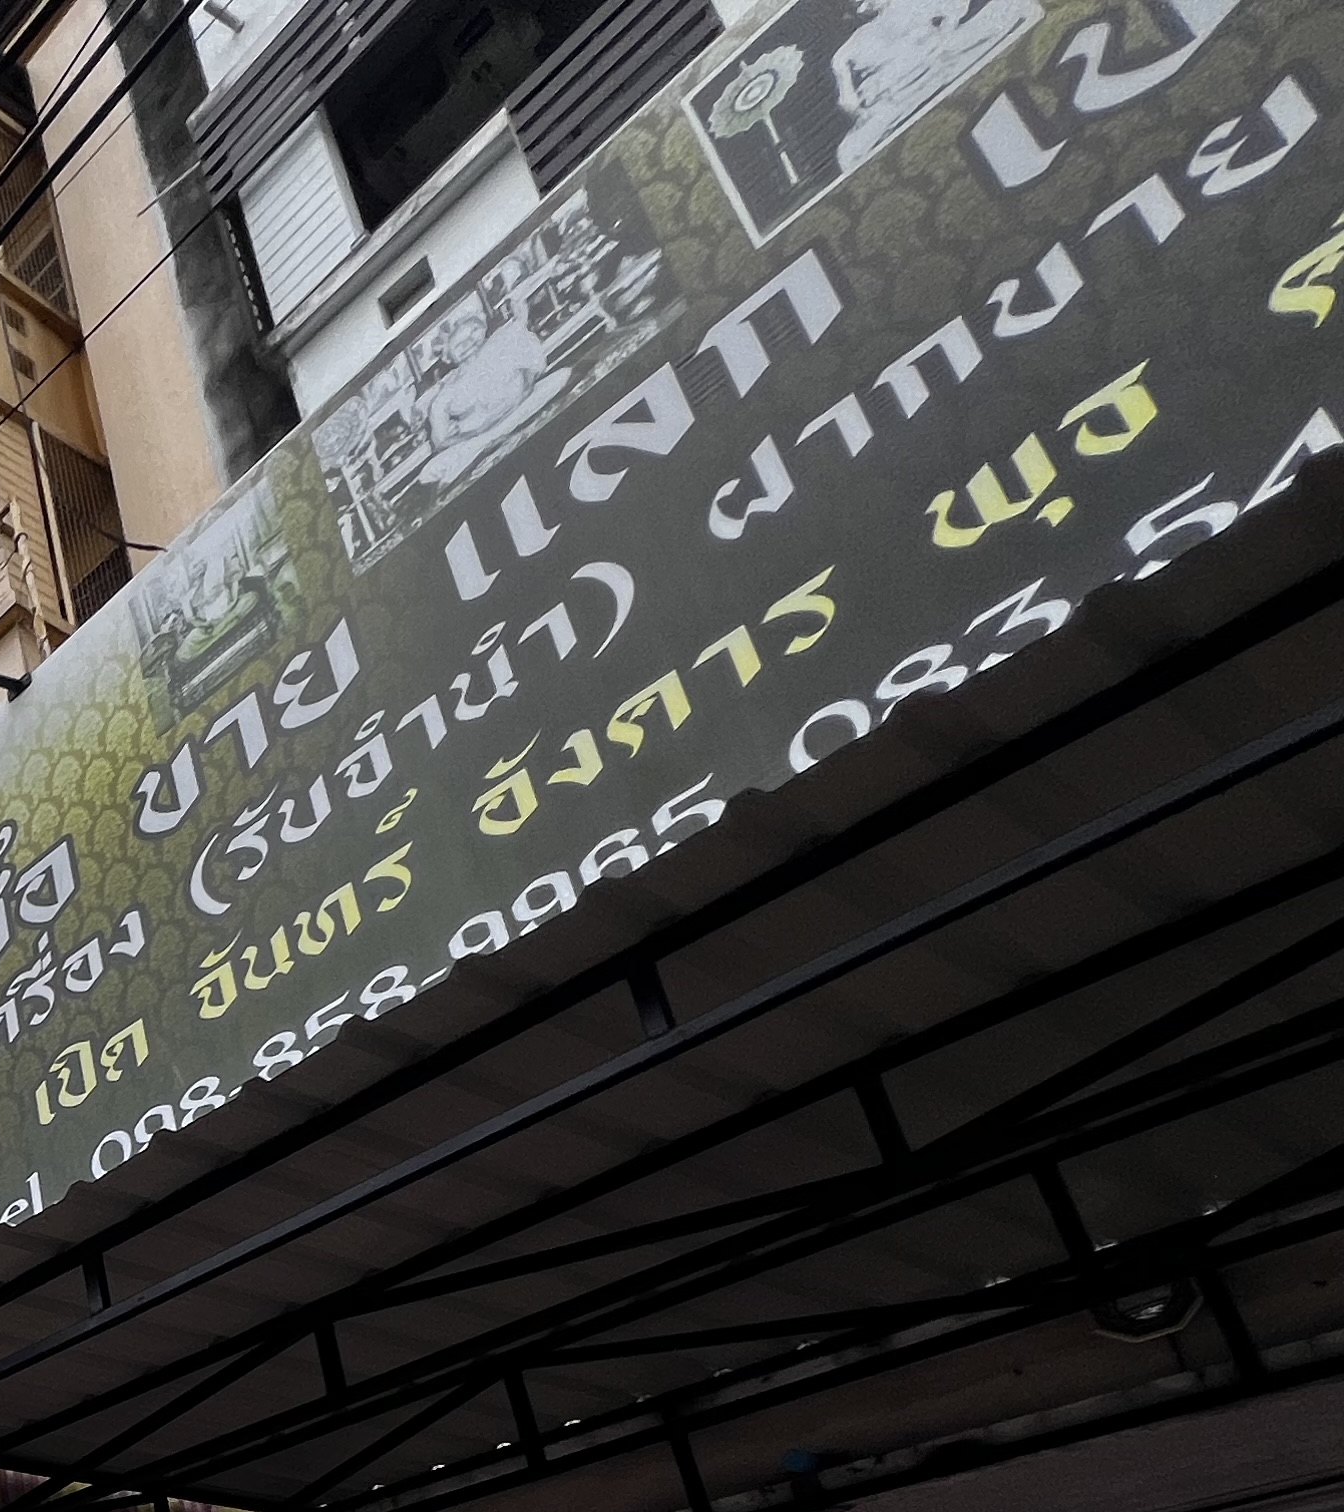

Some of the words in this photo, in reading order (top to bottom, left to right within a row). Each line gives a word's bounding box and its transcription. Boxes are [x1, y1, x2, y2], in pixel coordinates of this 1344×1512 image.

[33, 1018, 150, 1126] เปิด
[189, 788, 417, 1022] จันทร์
[471, 565, 835, 836] อังคาร
[925, 359, 1158, 548] พุธ
[135, 618, 361, 834] ขาย
[444, 248, 843, 601] แลก
[189, 561, 636, 916] (รับจำนำ)
[708, 73, 1319, 541] ฝากขาย
